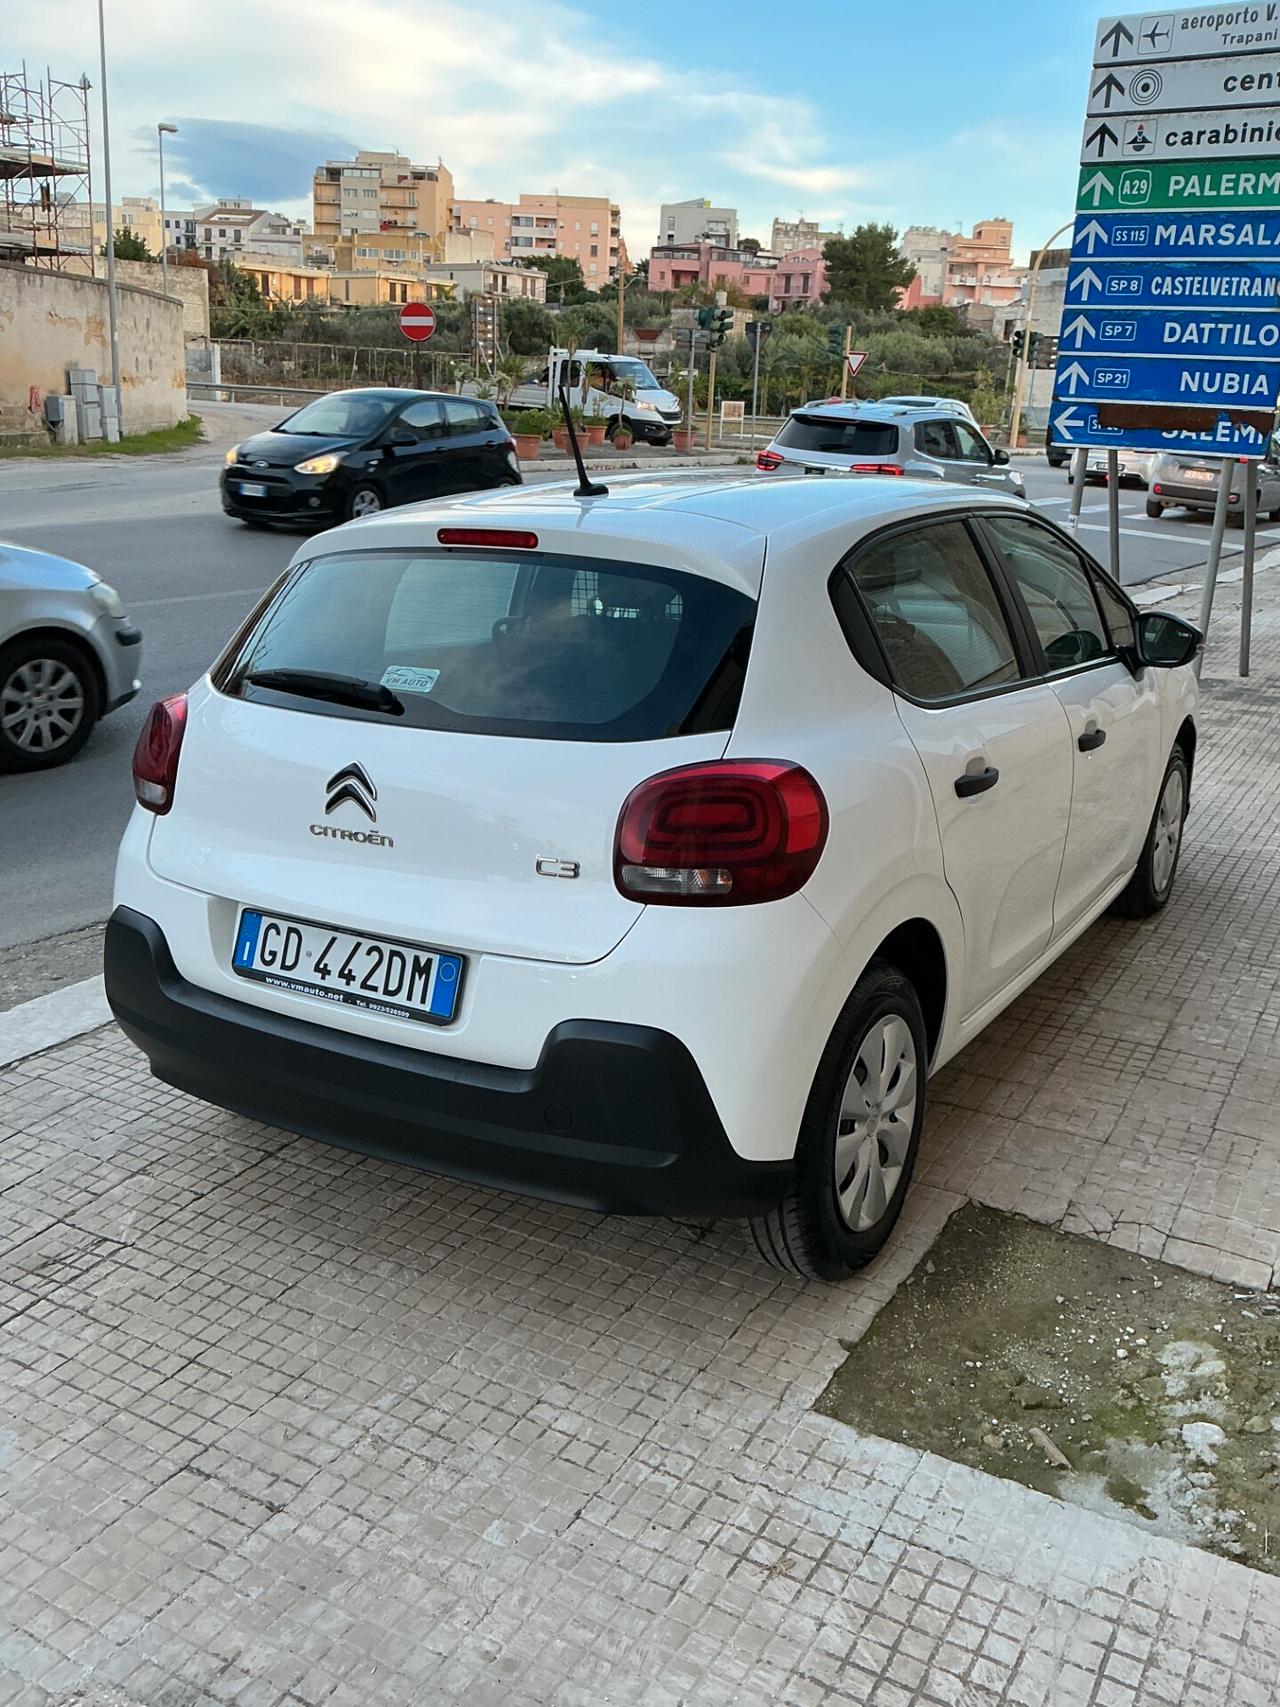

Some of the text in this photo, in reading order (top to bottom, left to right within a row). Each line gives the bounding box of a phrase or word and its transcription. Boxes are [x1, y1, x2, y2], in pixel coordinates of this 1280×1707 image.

[1181, 3, 1278, 31] aeroporto V.
[1222, 28, 1278, 45] Trapani
[1168, 172, 1280, 198] PALERM
[1115, 230, 1128, 242] SS
[1130, 230, 1146, 242] 115
[1110, 279, 1128, 292] SP
[1130, 279, 1139, 292] 8
[1104, 322, 1279, 347] SP 7 DATTILO
[1179, 370, 1269, 396] NUBIA
[401, 679, 429, 688] AUTO
[309, 823, 394, 848] CITROËN
[535, 856, 581, 879] C3
[259, 922, 303, 972] GD
[313, 935, 433, 1005] 442DM
[265, 975, 344, 1003] www.vmauto.net
